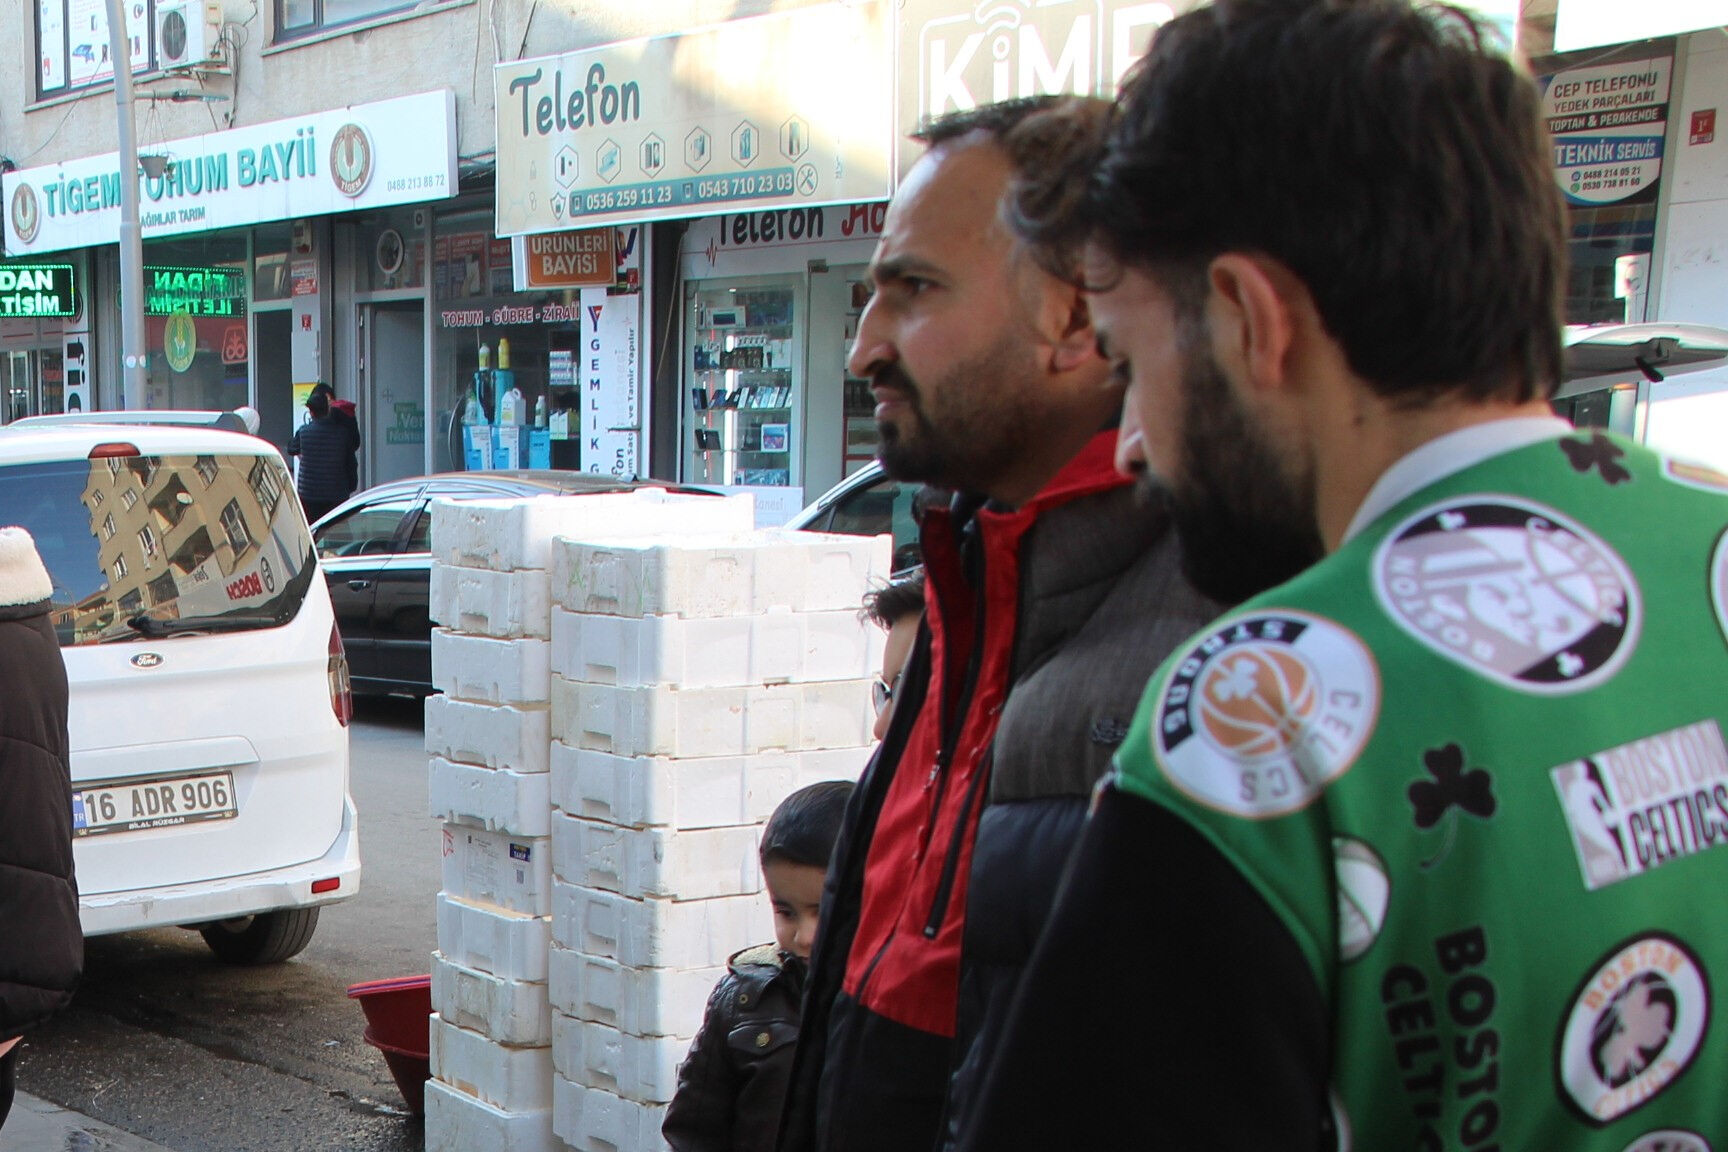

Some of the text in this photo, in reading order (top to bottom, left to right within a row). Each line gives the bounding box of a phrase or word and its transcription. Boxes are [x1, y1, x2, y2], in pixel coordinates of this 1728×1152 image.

[510, 61, 640, 138] Telefon
[1554, 71, 1658, 99] CEP TELEFONU
[1554, 90, 1656, 113] YEDEK PARÇALARI
[1554, 138, 1657, 165] TEKNİK SERVİS
[42, 172, 122, 218] TİGEM
[586, 173, 793, 210] 0536 259 11 23 0543 710 23 03
[179, 206, 206, 222] TARIM
[442, 309, 484, 328] TOHUM
[492, 305, 534, 324] GÜBRE
[73, 779, 228, 823] TR 16 ADR 906
[1629, 783, 1728, 867] CELTICS
